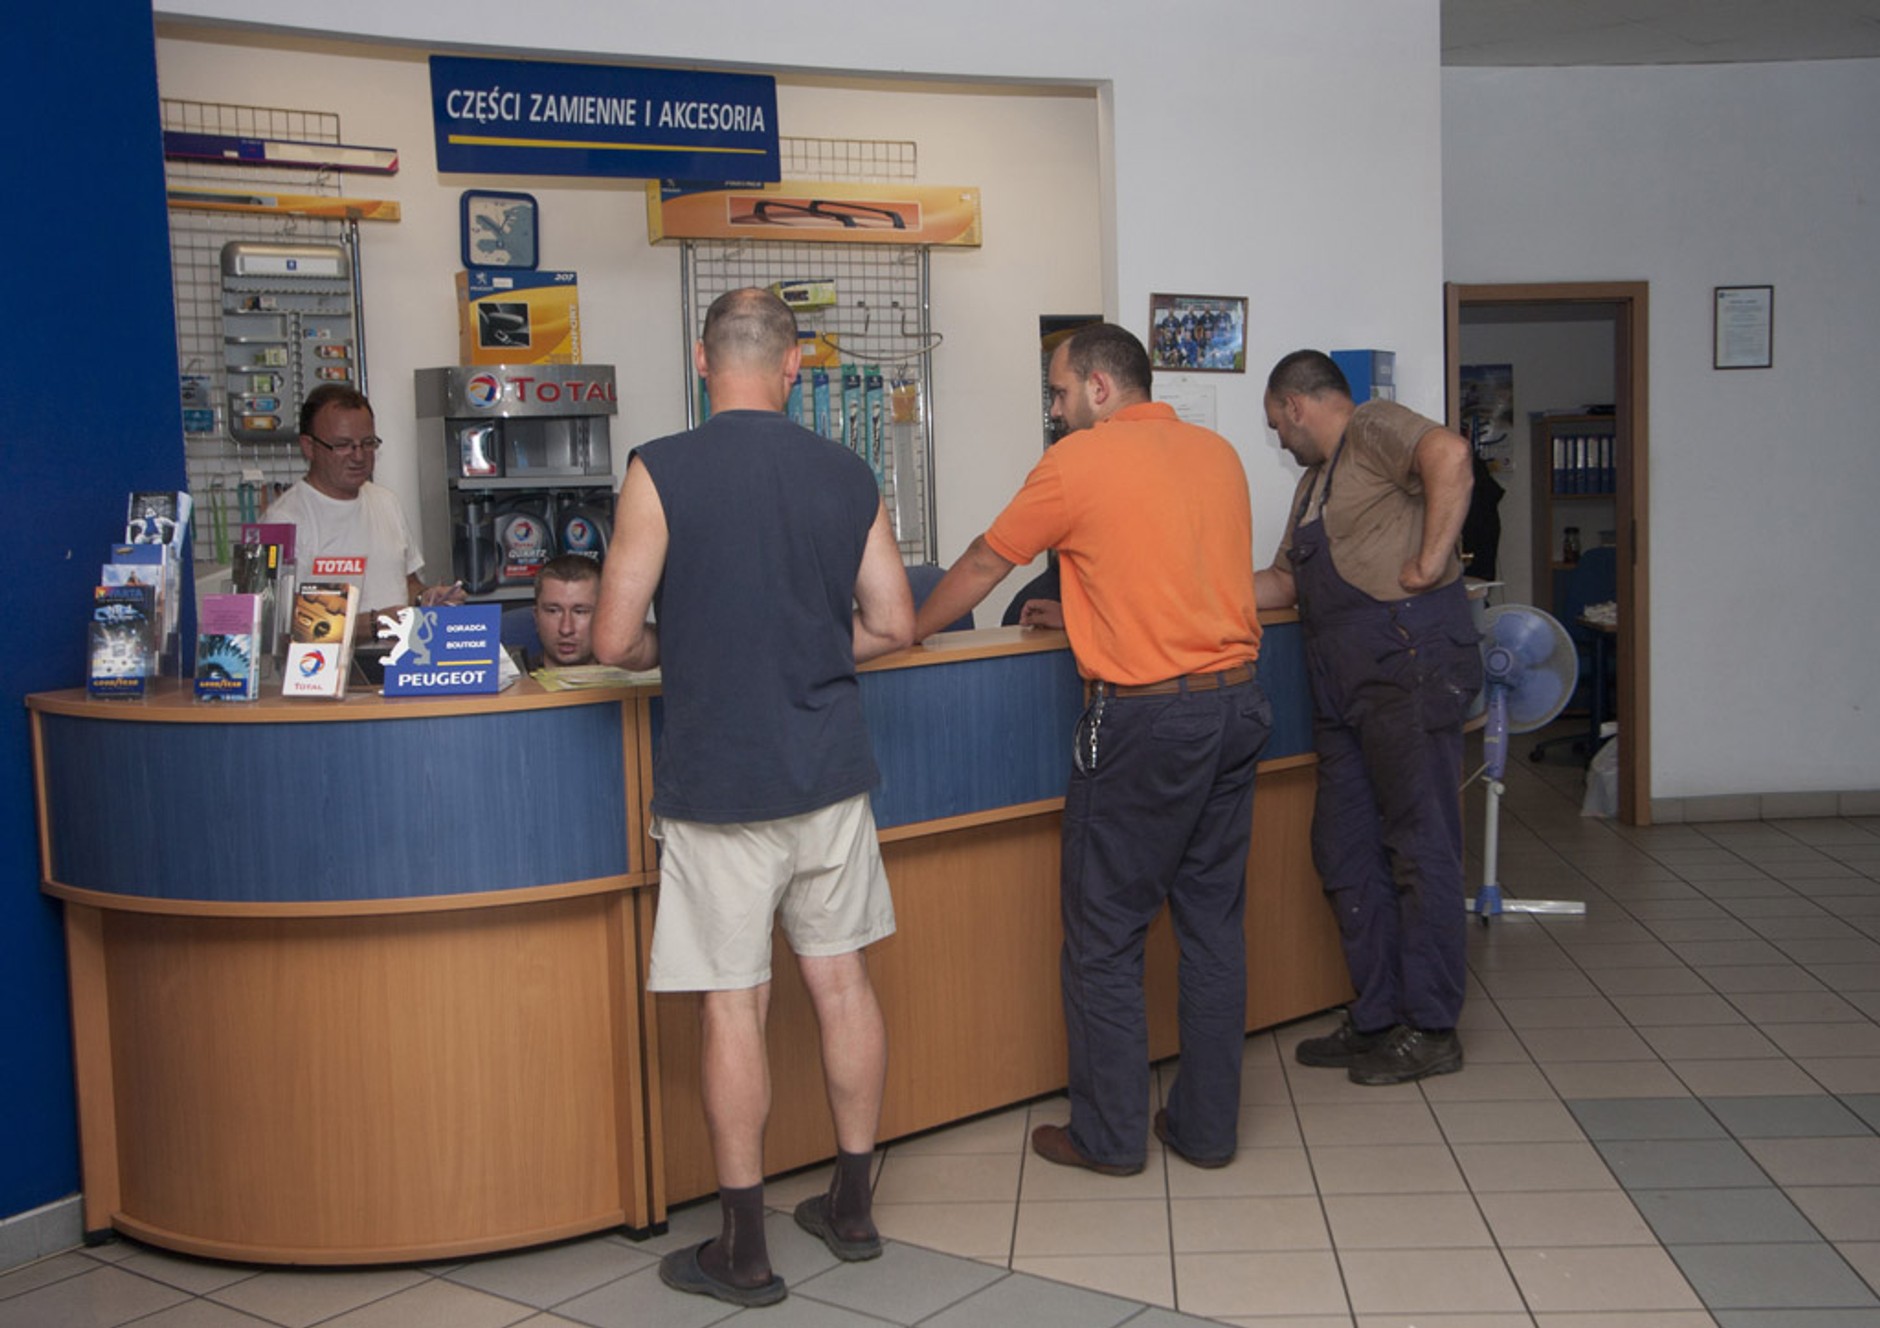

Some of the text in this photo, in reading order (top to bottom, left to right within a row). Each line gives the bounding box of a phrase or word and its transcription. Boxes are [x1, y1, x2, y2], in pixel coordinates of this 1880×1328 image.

[446, 85, 766, 132] CZĘŚCI ZAMIENNE I AKCESORIA
[506, 375, 618, 403] TOTAL
[315, 560, 363, 573] TOTAL
[446, 623, 487, 633] DORADCA
[446, 640, 487, 650] BOUTIQUE
[398, 670, 486, 687] PEUGEOT
[294, 682, 323, 691] TOTAL
